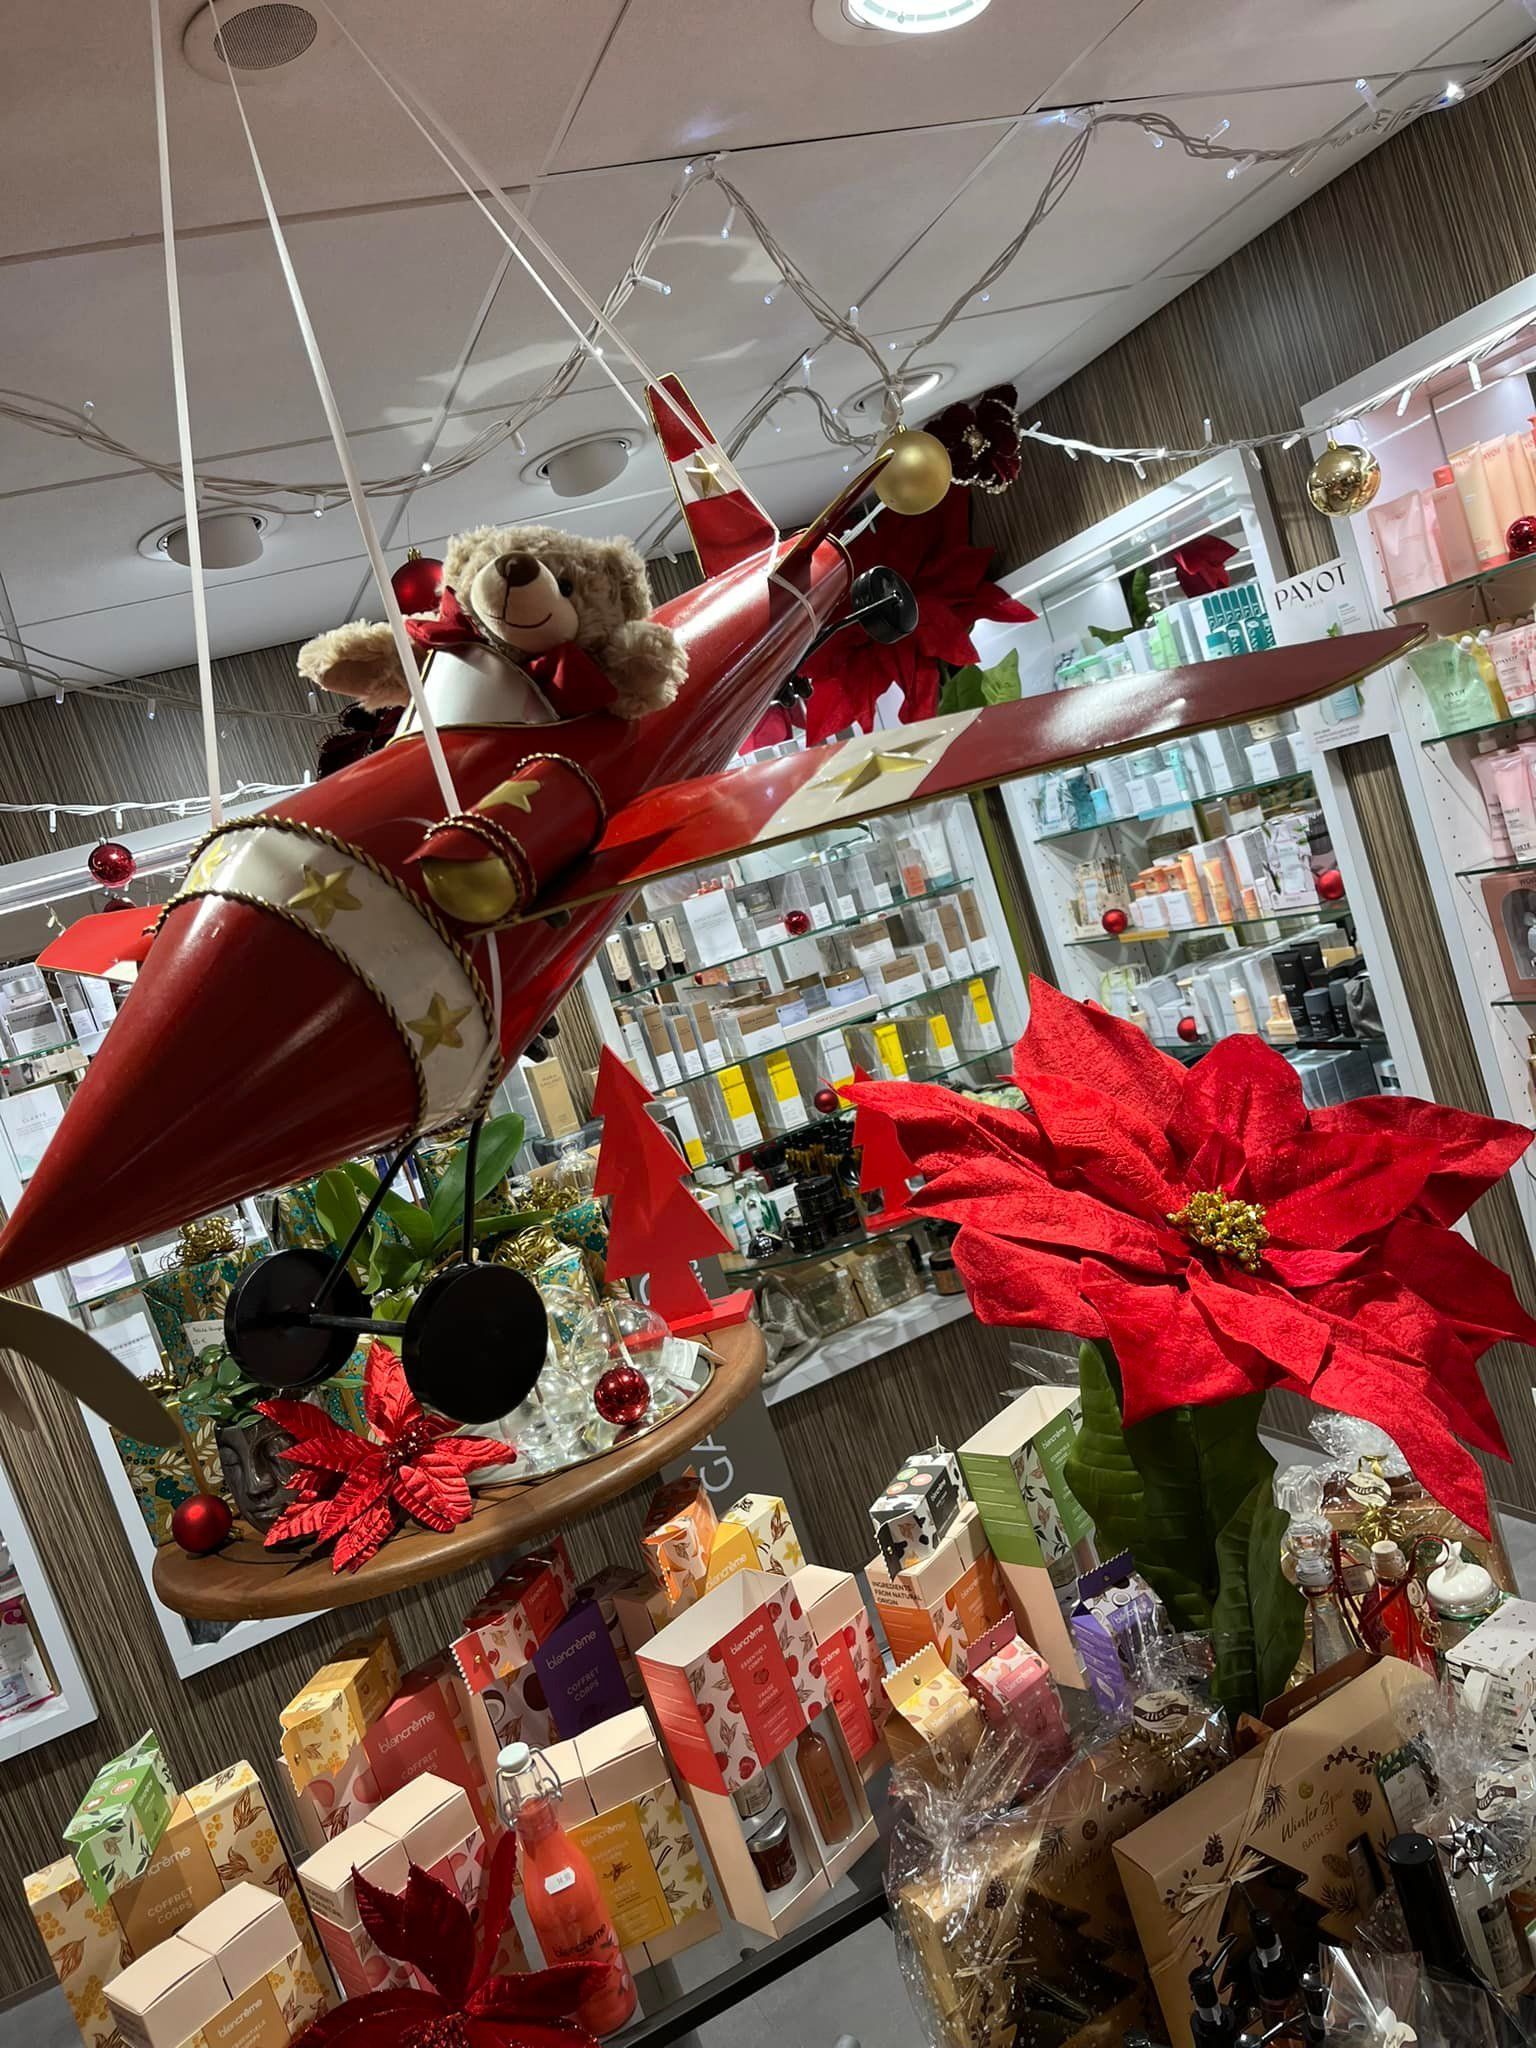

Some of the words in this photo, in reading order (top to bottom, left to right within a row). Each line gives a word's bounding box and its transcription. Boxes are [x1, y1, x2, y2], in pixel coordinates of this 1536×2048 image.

[1274, 562, 1347, 611] PAYOT
[545, 1630, 597, 1671] blancrème
[730, 1624, 765, 1656] blancrème
[379, 1711, 436, 1755] blancrème
[1281, 1805, 1319, 1844] Winter
[148, 1886, 193, 1918] COFFRET
[156, 1901, 193, 1925] CORPS
